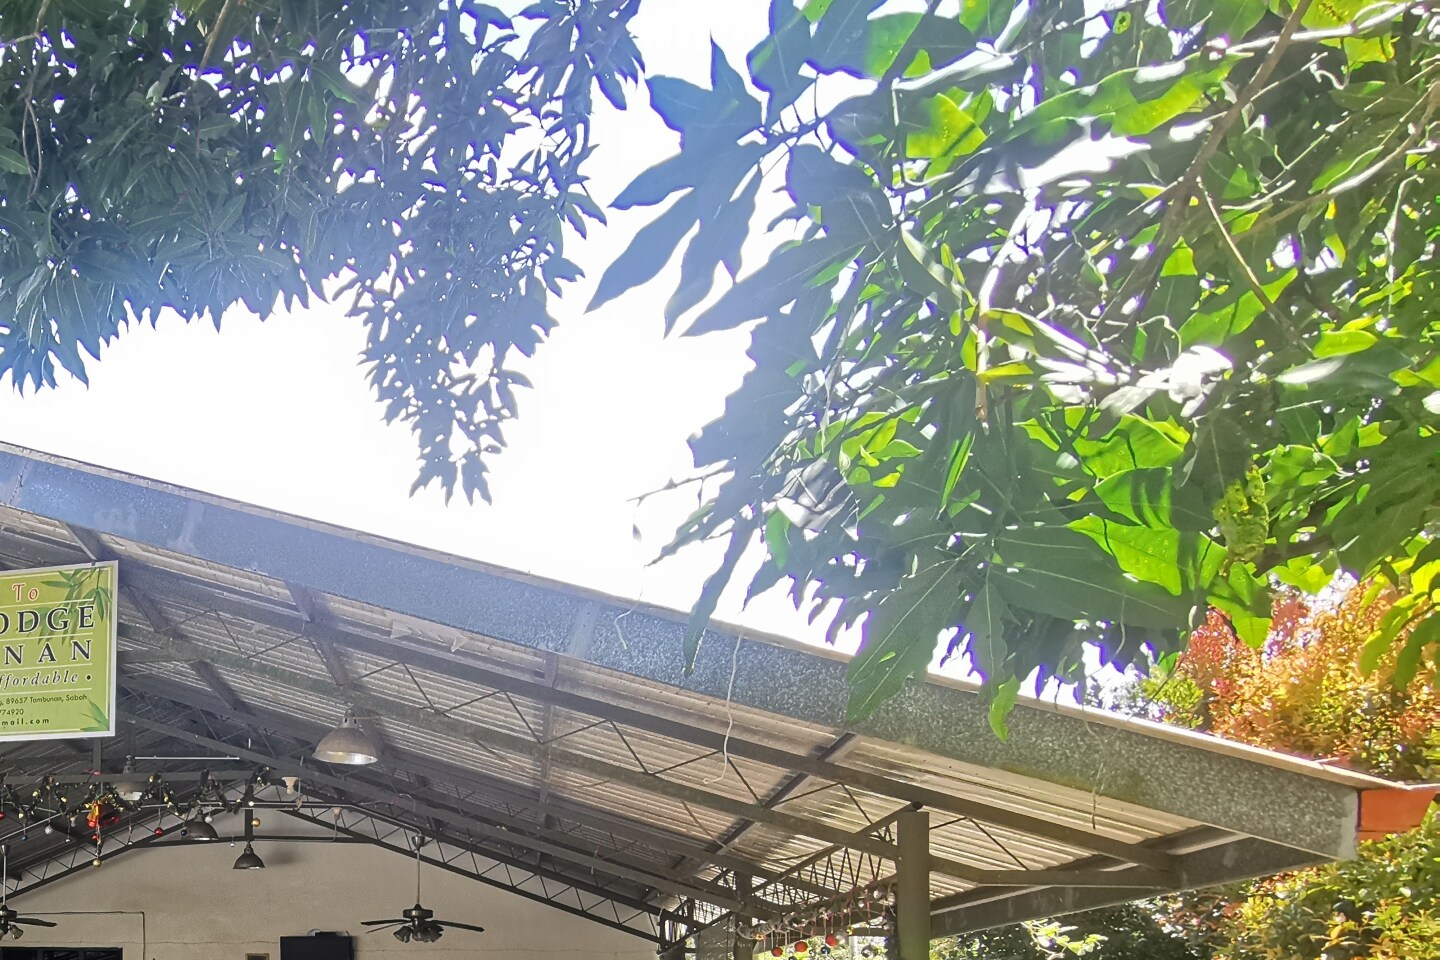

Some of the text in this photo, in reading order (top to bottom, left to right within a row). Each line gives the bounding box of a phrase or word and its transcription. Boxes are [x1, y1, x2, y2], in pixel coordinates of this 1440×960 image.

[12, 583, 39, 602] To
[6, 696, 28, 704] 89657
[30, 696, 64, 704] Tambunan,
